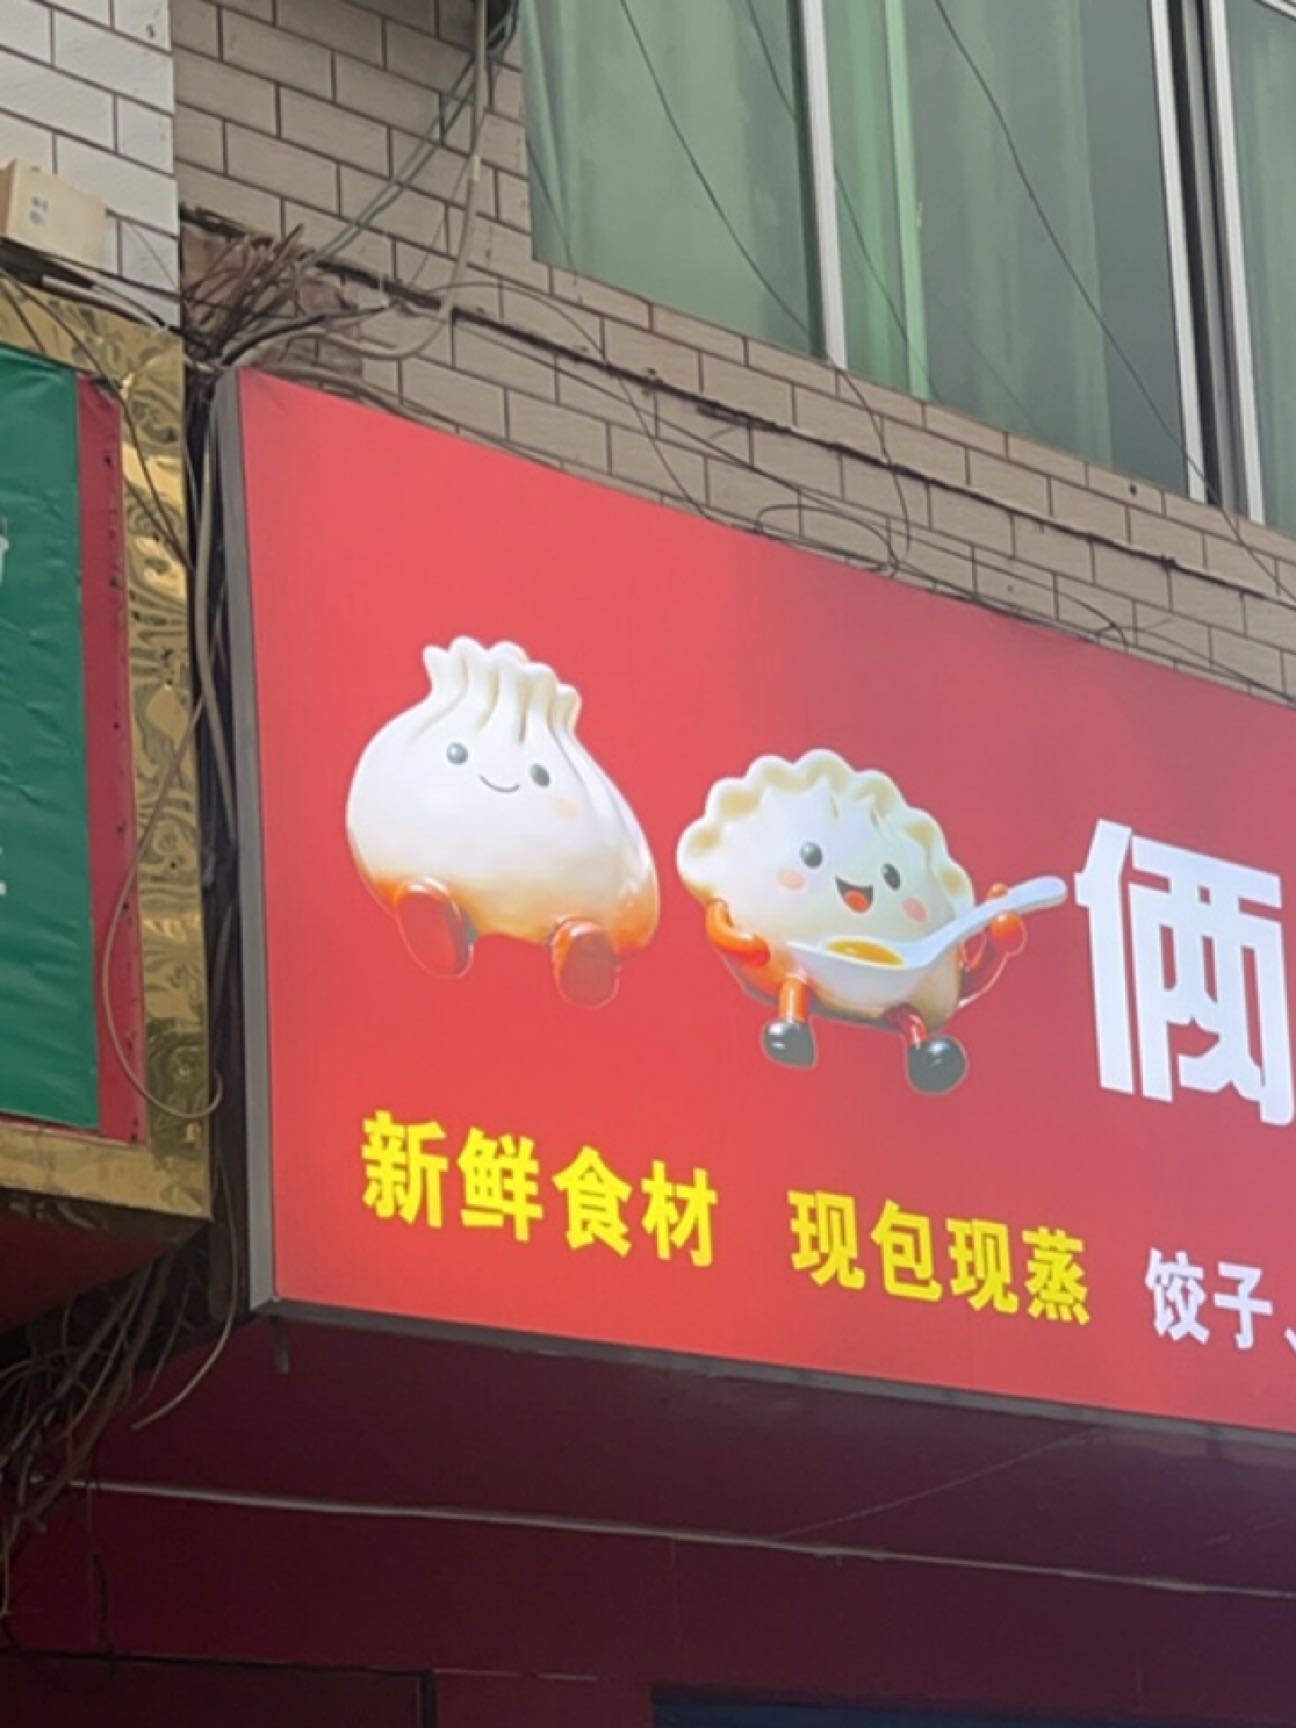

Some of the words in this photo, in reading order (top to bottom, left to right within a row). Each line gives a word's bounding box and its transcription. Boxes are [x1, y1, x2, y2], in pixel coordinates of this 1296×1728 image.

[361, 1110, 718, 1267] 新鲜食材
[788, 1189, 1091, 1325] 现包现蒸
